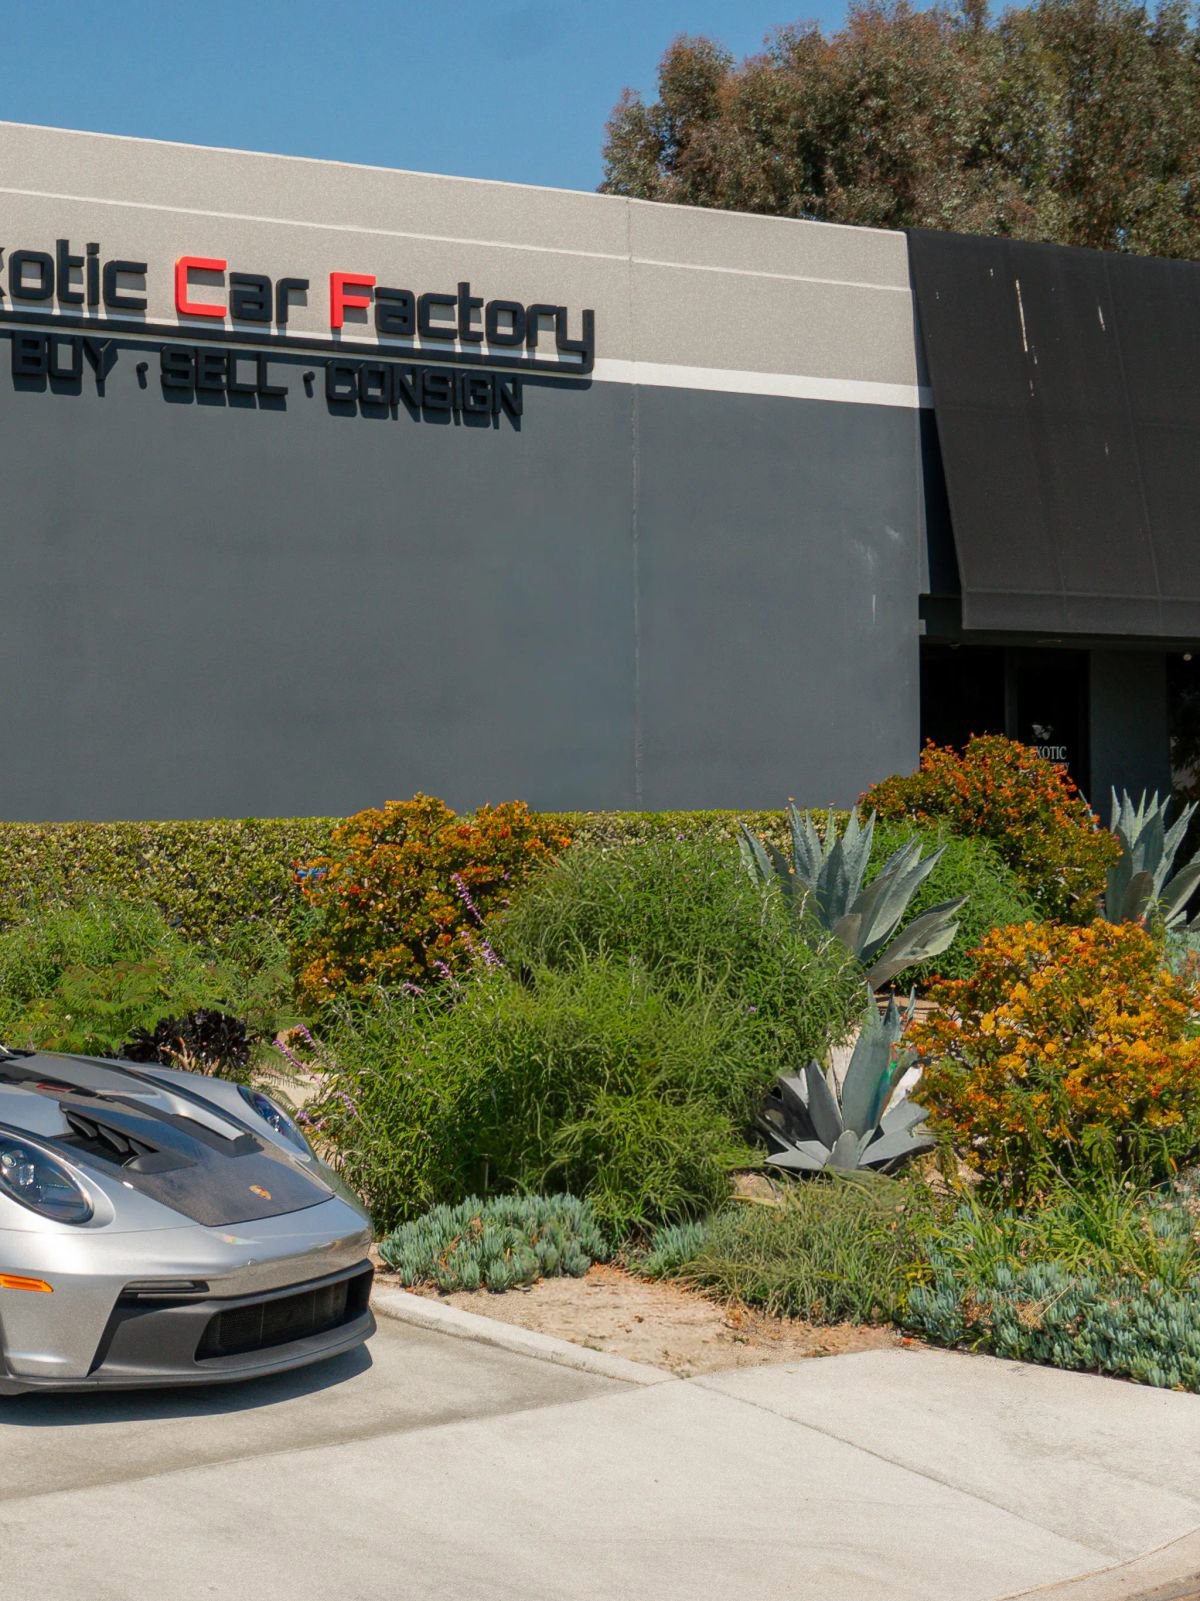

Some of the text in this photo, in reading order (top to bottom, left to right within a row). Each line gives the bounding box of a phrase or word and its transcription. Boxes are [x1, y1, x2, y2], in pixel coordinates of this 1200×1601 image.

[175, 256, 309, 323] Car
[330, 271, 595, 374] Factory
[11, 332, 523, 416] BUY SELL CONSIGN
